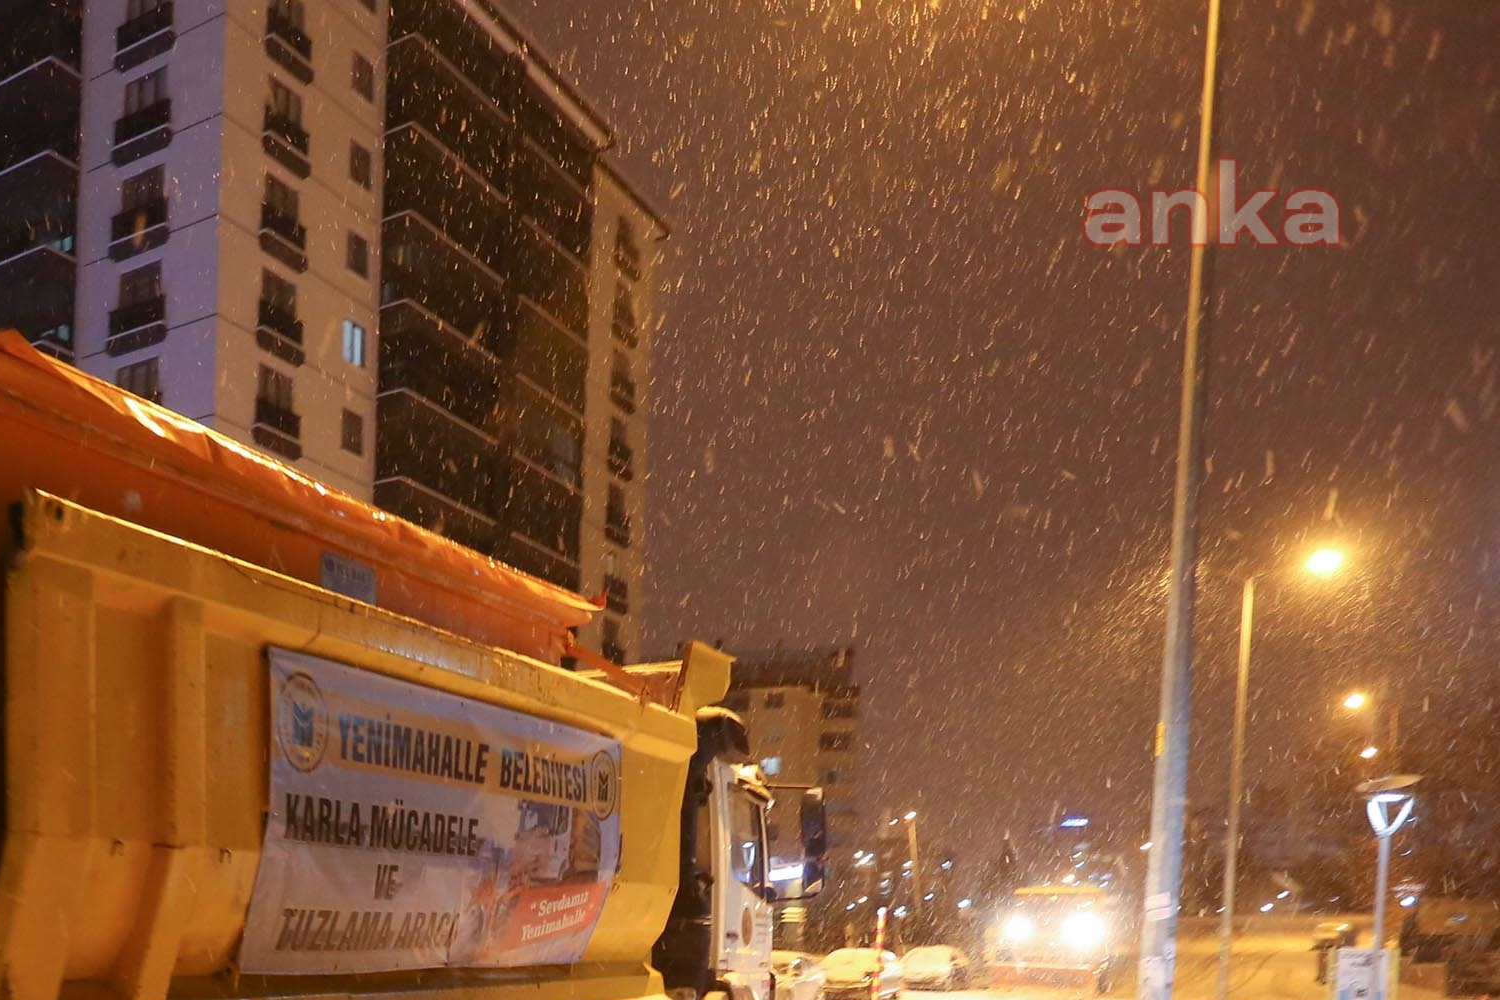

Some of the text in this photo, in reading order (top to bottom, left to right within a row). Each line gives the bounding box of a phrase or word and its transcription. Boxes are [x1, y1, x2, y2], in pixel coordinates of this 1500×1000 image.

[337, 712, 587, 803] YENİMAHALLE BELEDİYESİ
[283, 792, 479, 857] KARLA MÜCADELE
[374, 864, 399, 901] VE
[276, 907, 392, 952] TUZLAMA
